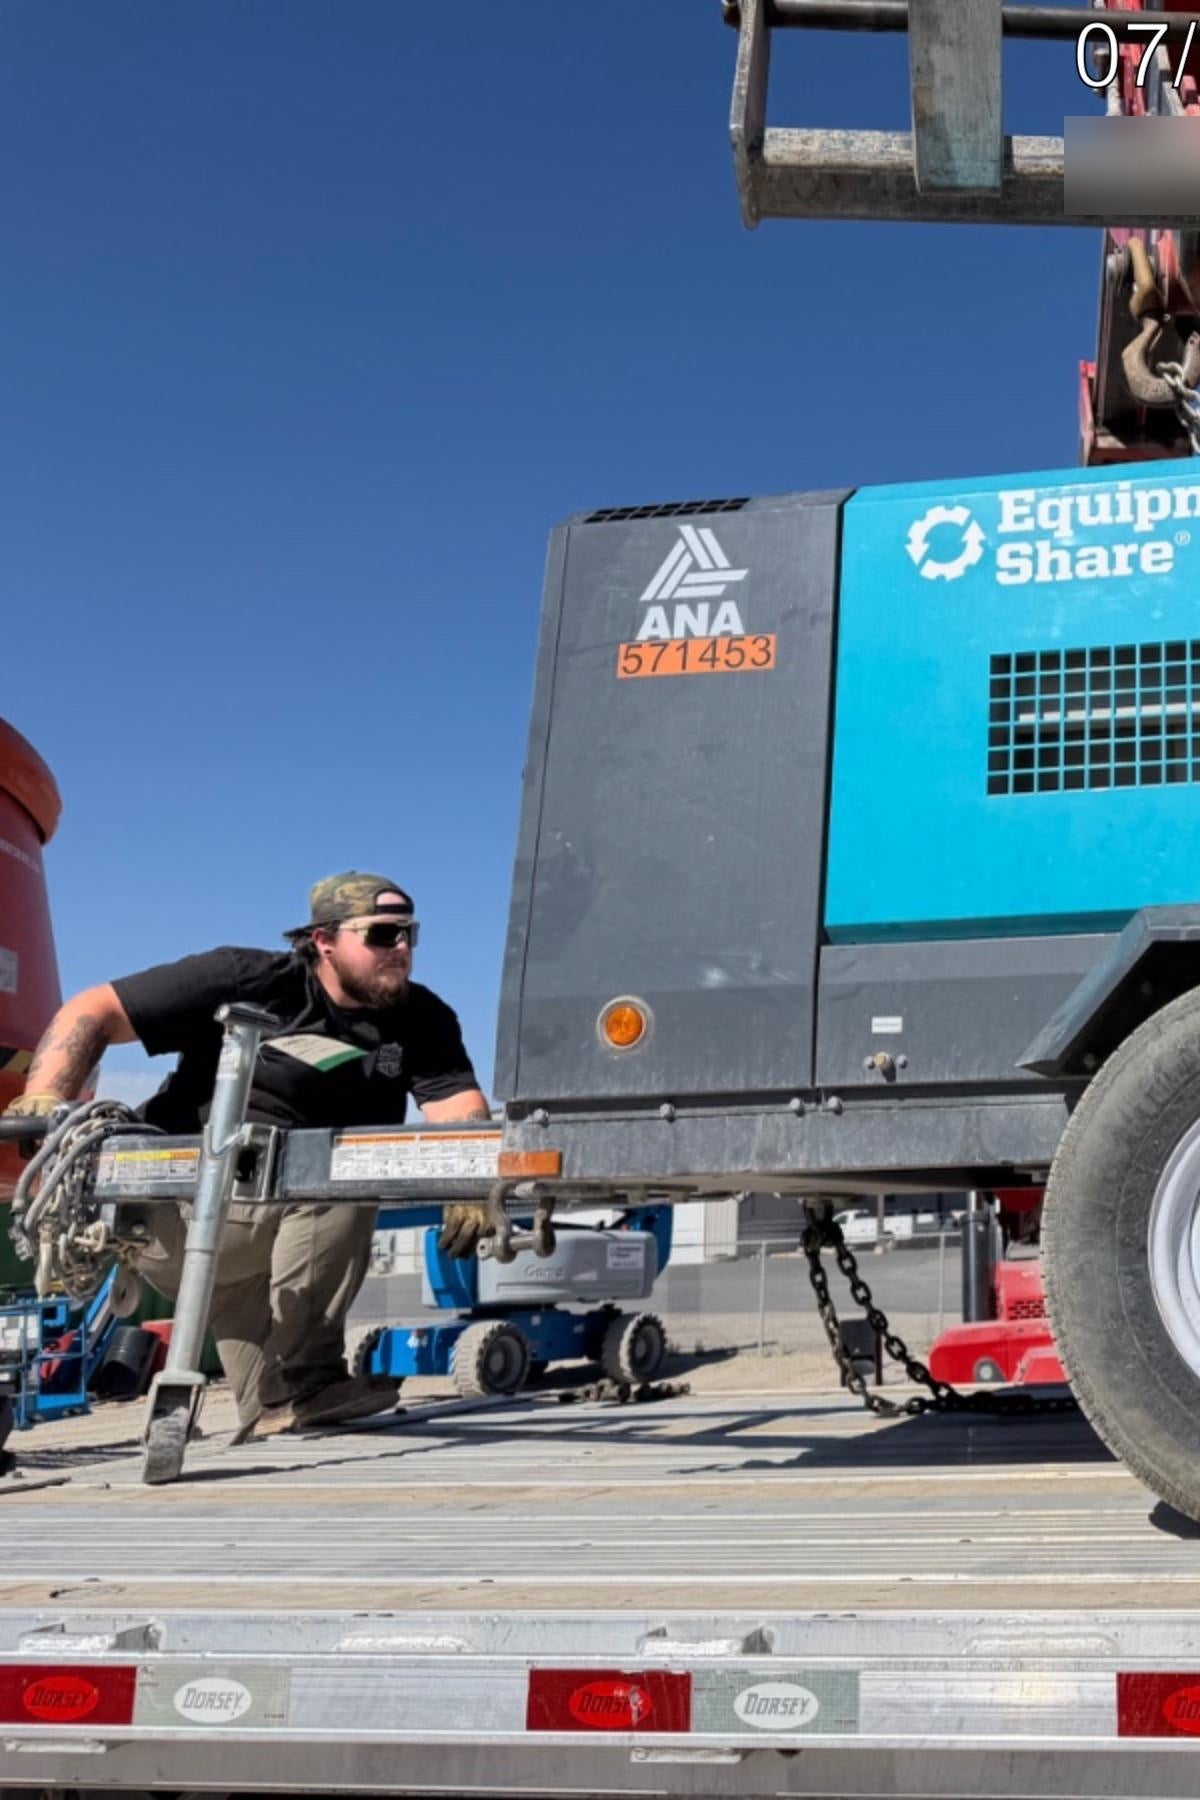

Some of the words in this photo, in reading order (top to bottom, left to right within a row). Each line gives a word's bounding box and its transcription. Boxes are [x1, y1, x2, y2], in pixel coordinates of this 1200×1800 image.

[636, 600, 745, 641] ANA
[621, 636, 773, 675] 571453
[31, 1686, 92, 1709] DORSEY
[181, 1687, 244, 1710] DORSEY
[743, 1692, 810, 1716] DORSEY
